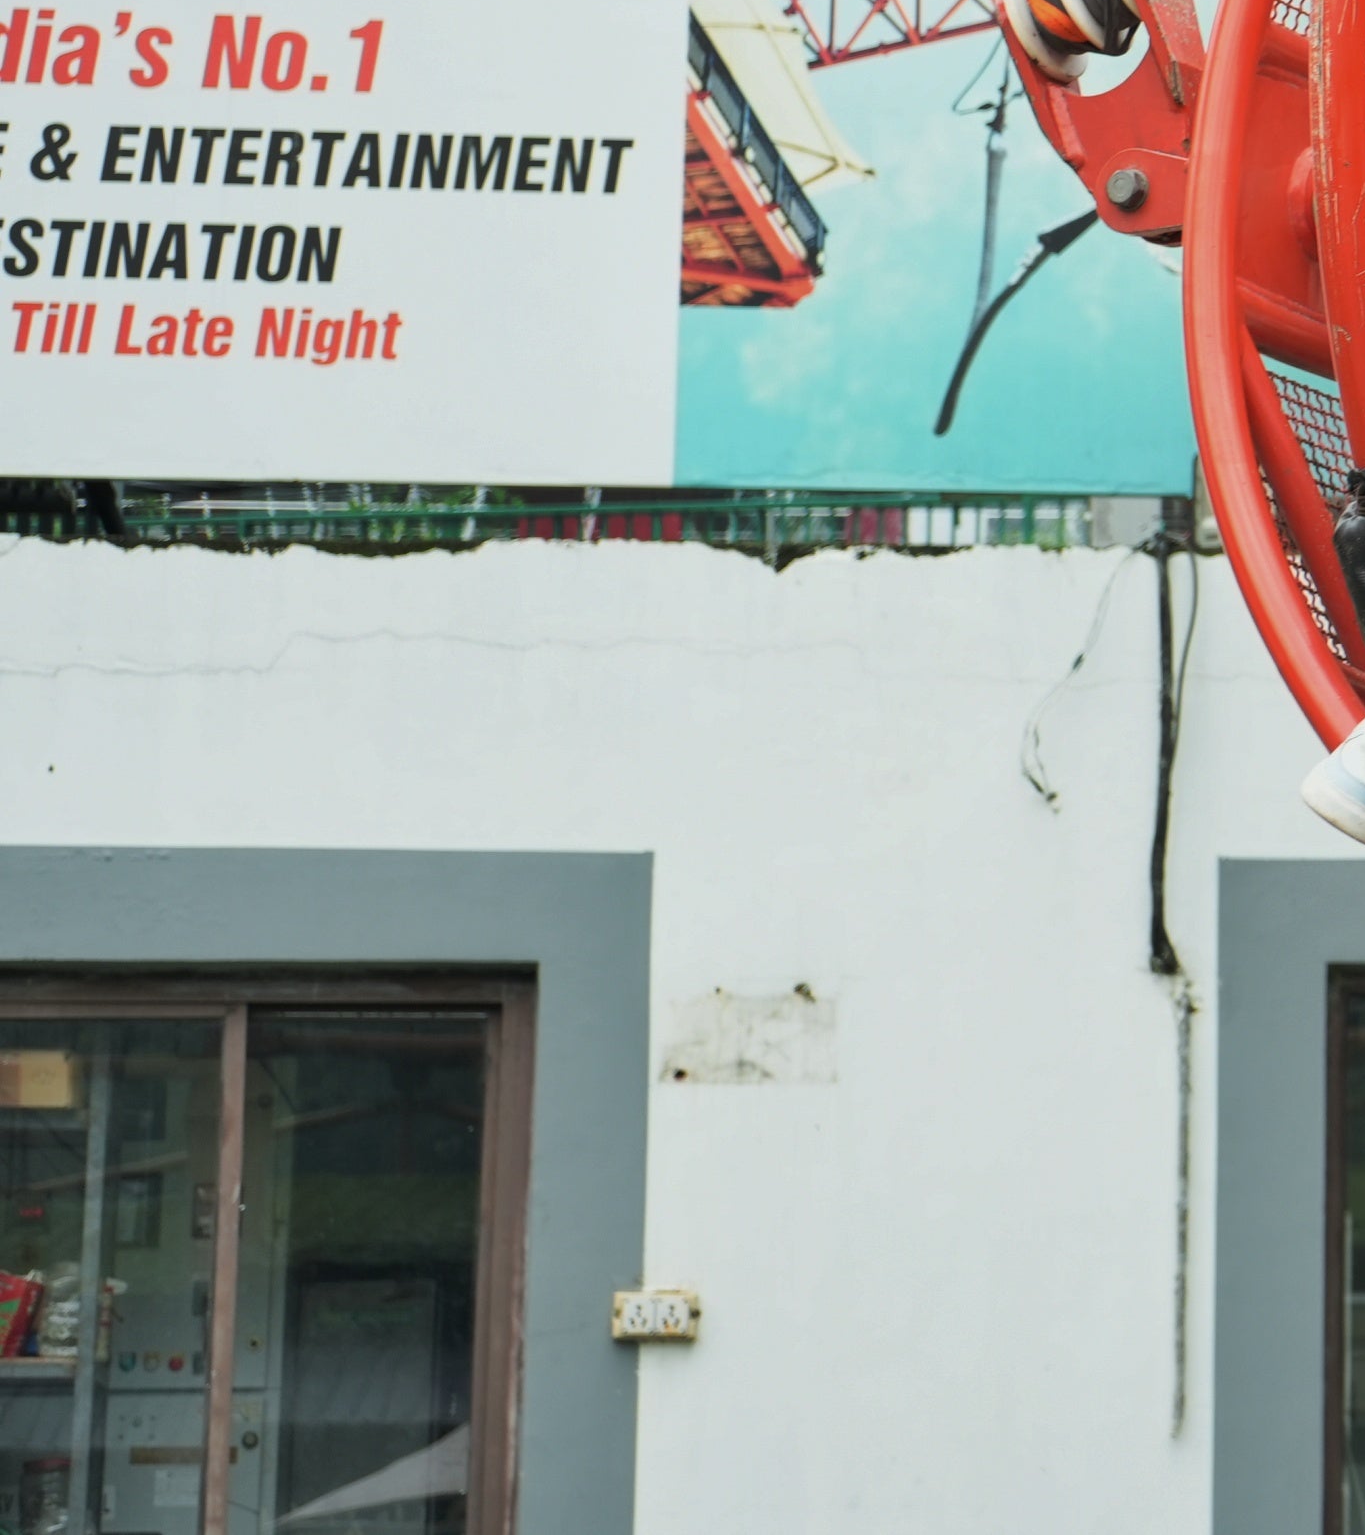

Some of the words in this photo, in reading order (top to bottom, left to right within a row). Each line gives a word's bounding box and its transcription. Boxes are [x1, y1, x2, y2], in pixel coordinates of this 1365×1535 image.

[30, 122, 78, 182] &
[99, 125, 634, 194] ENTERTAINMENT
[0, 218, 342, 283] STINATION
[12, 301, 97, 355] Till
[114, 303, 234, 359] Late
[254, 306, 403, 366] Night
